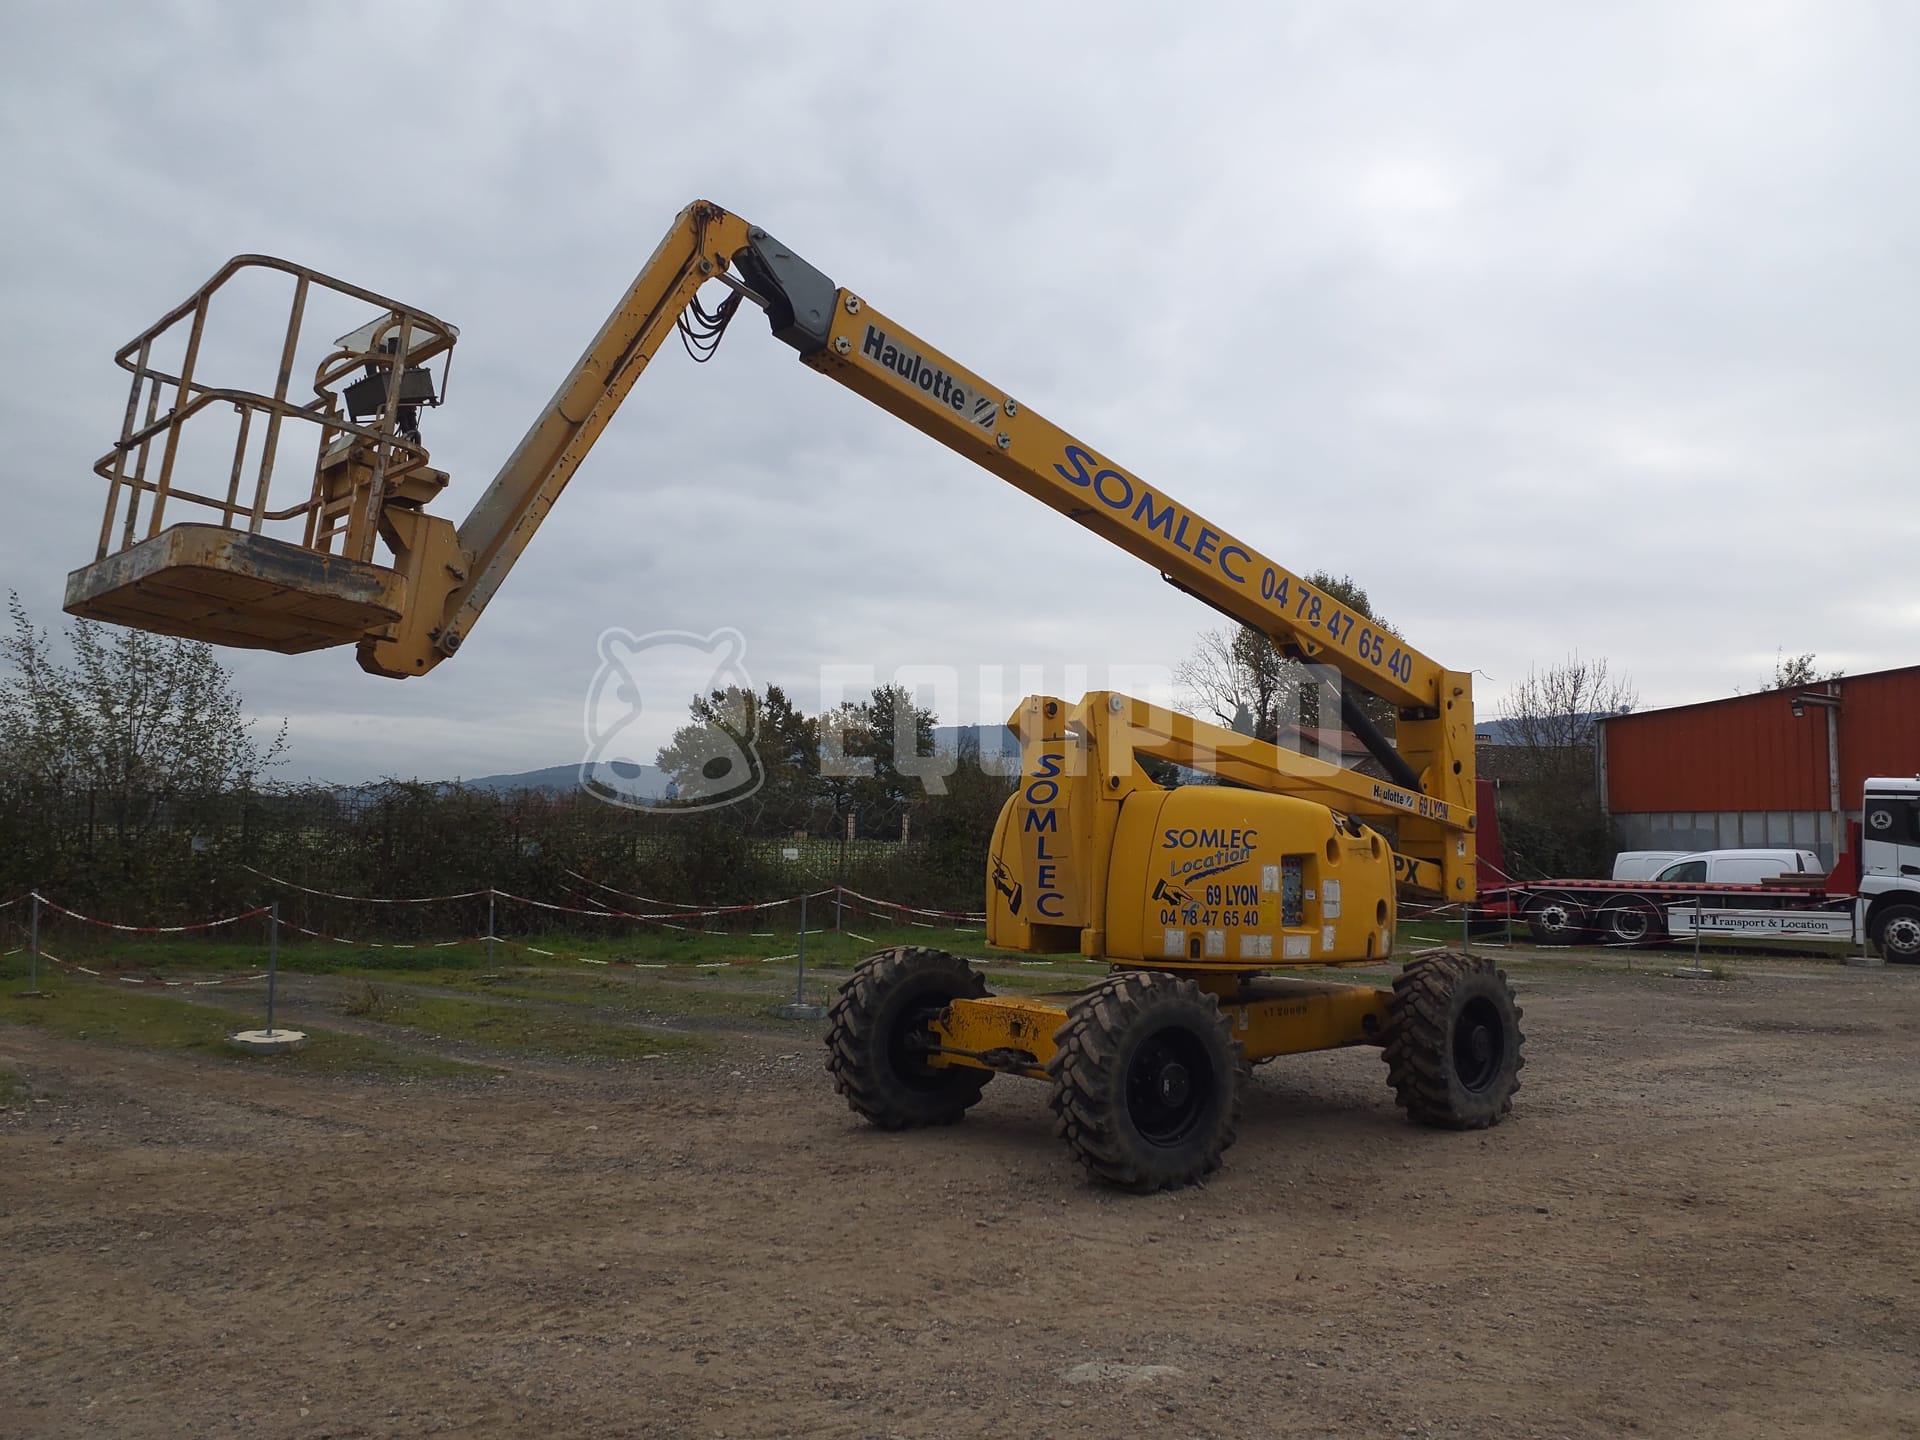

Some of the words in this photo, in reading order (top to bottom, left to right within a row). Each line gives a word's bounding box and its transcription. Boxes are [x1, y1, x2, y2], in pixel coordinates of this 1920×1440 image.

[863, 325, 965, 411] Haulotte
[1053, 445, 1252, 583] SOMLEC
[1261, 567, 1288, 609] 04
[1296, 587, 1321, 628] 78
[1327, 610, 1355, 645] 47
[1358, 628, 1384, 666] 65
[1388, 648, 1412, 684] 40
[1024, 754, 1064, 918] SOMLEC
[1161, 829, 1258, 850] SOMLEC
[1170, 847, 1251, 877] Location
[1206, 885, 1222, 906] 69
[1226, 885, 1259, 906] LYON
[1160, 909, 1177, 926] 04
[1181, 909, 1198, 926] 78
[1202, 909, 1219, 926] 47
[1223, 910, 1239, 926] 65
[1243, 910, 1259, 926] 40
[1768, 919, 1778, 928] &
[1781, 919, 1829, 930] Location
